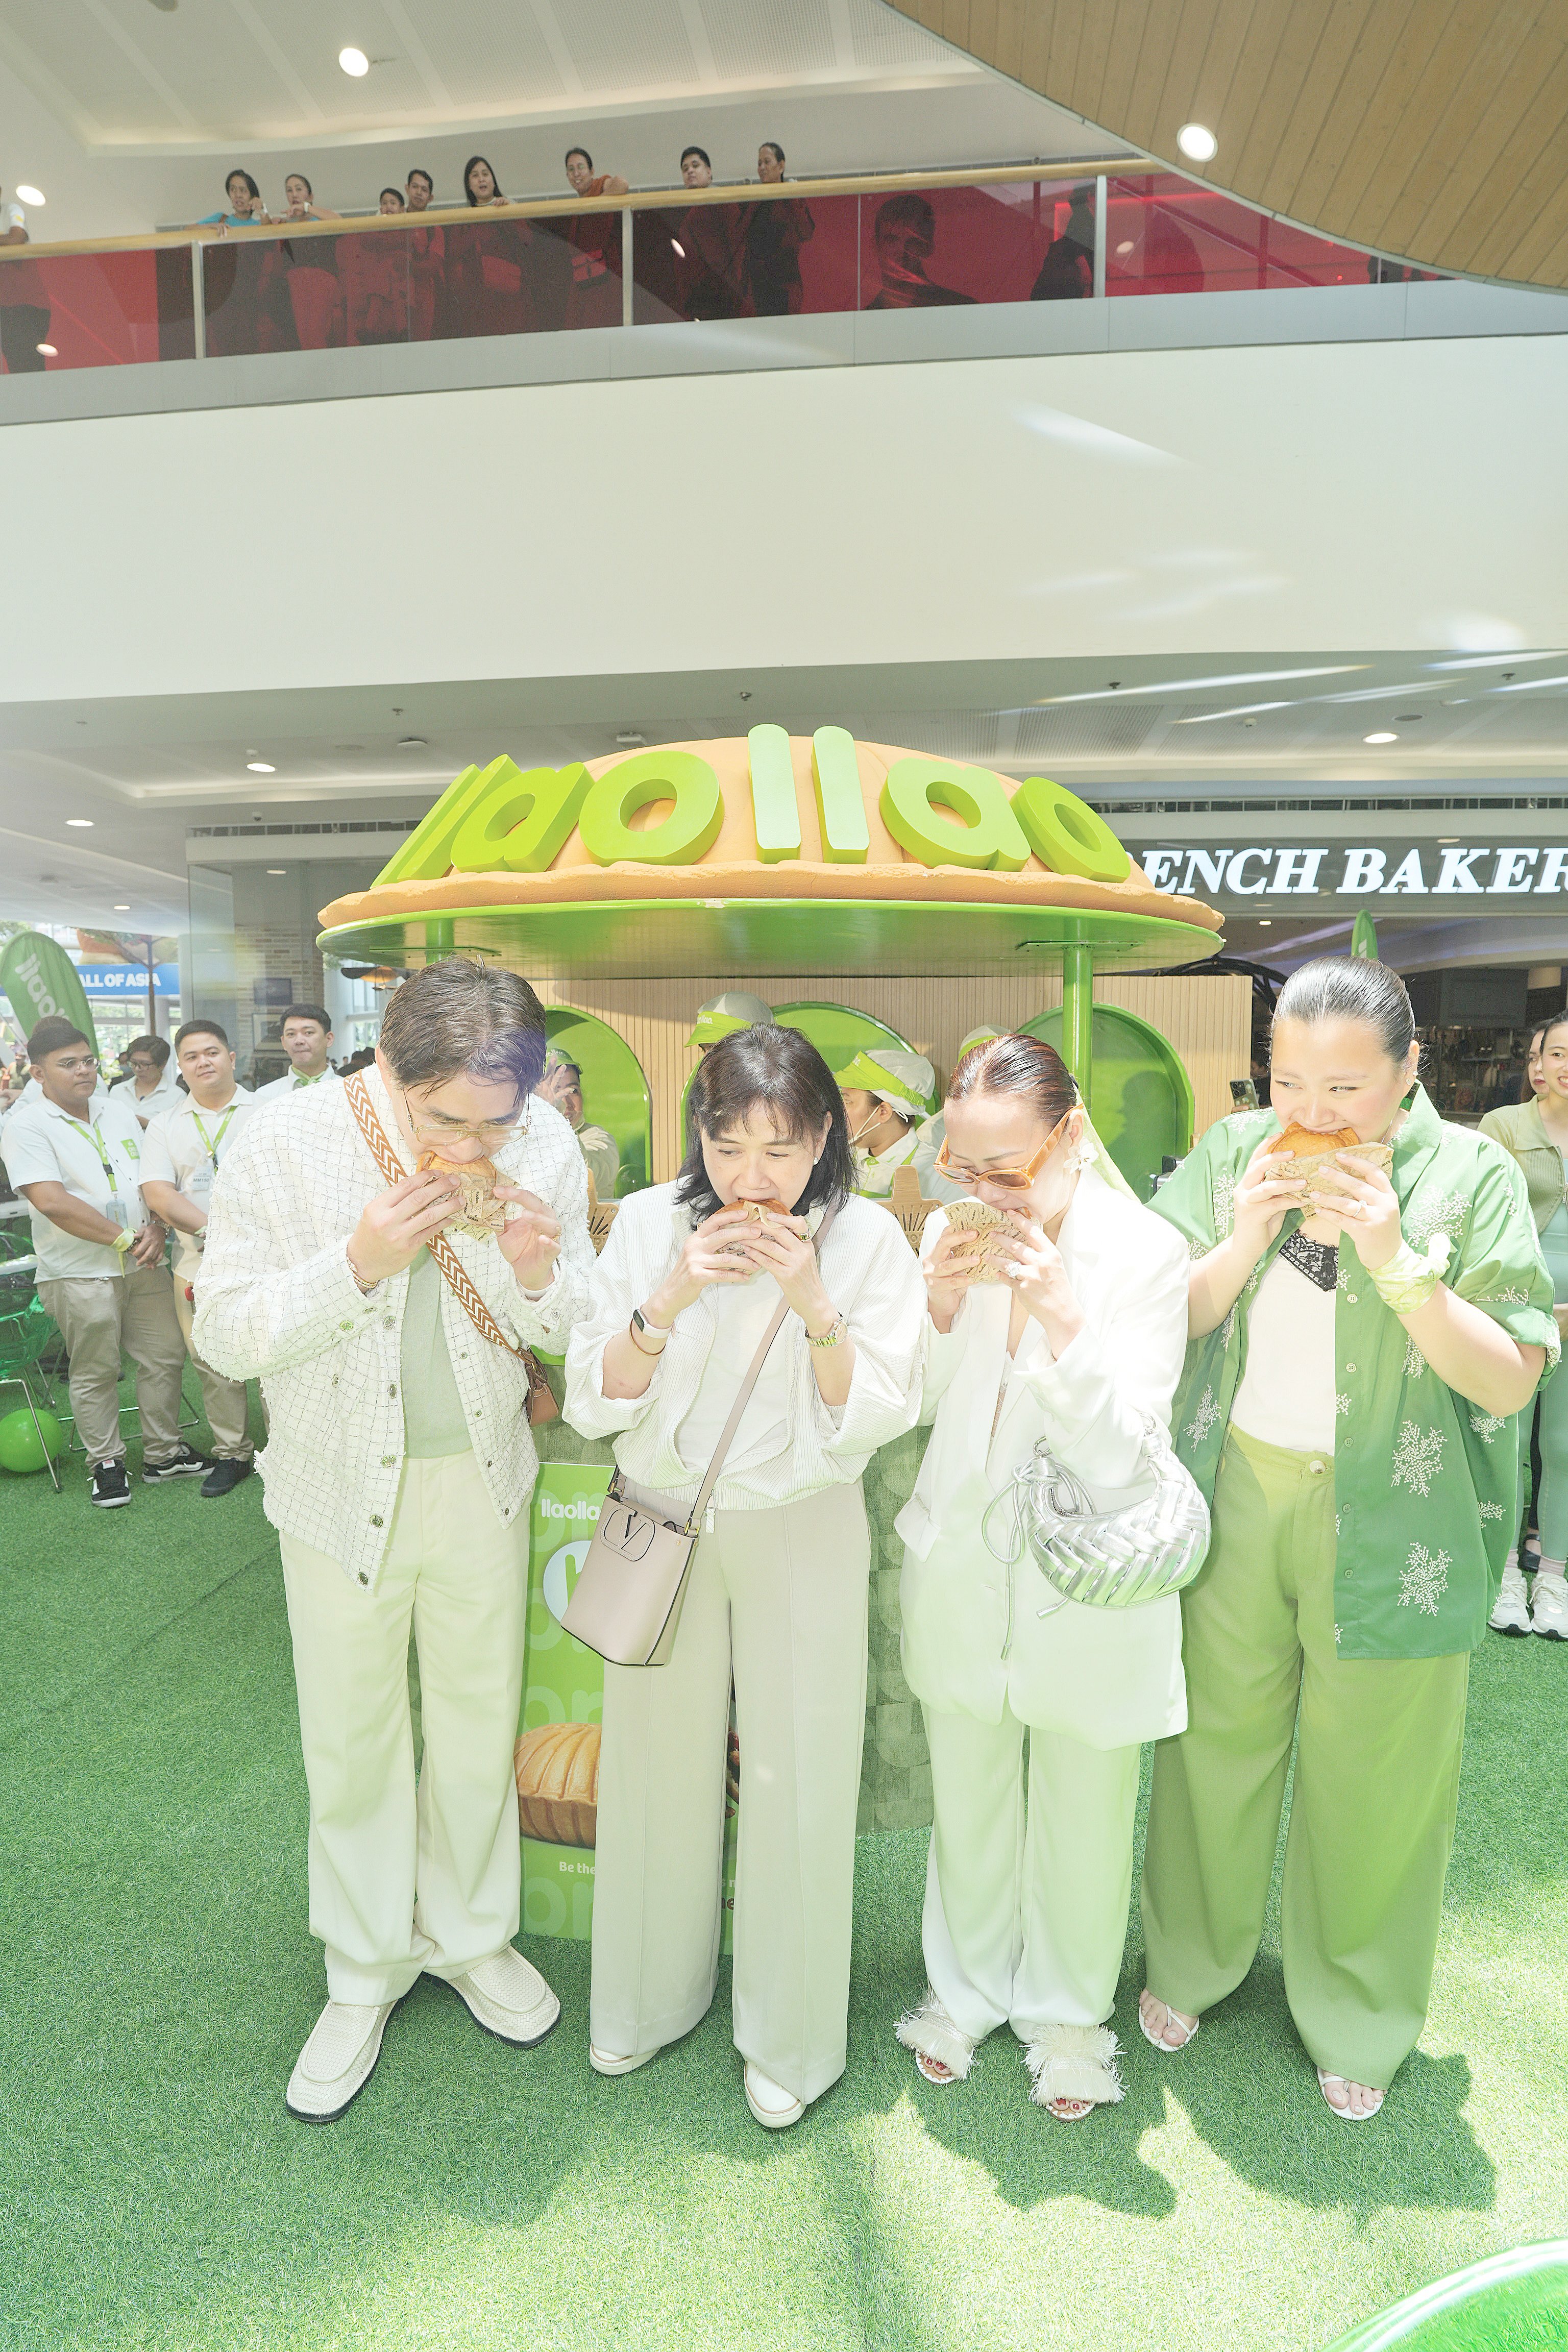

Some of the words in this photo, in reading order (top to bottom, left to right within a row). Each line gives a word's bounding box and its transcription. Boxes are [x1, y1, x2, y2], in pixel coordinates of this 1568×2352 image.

[370, 724, 1130, 889] llaollao
[1125, 848, 1328, 894] ENCH
[104, 973, 125, 987] OF
[125, 973, 161, 987] ASIA
[542, 1499, 601, 1520] llaolla
[559, 1861, 574, 1873] Be
[577, 1863, 595, 1875] the
